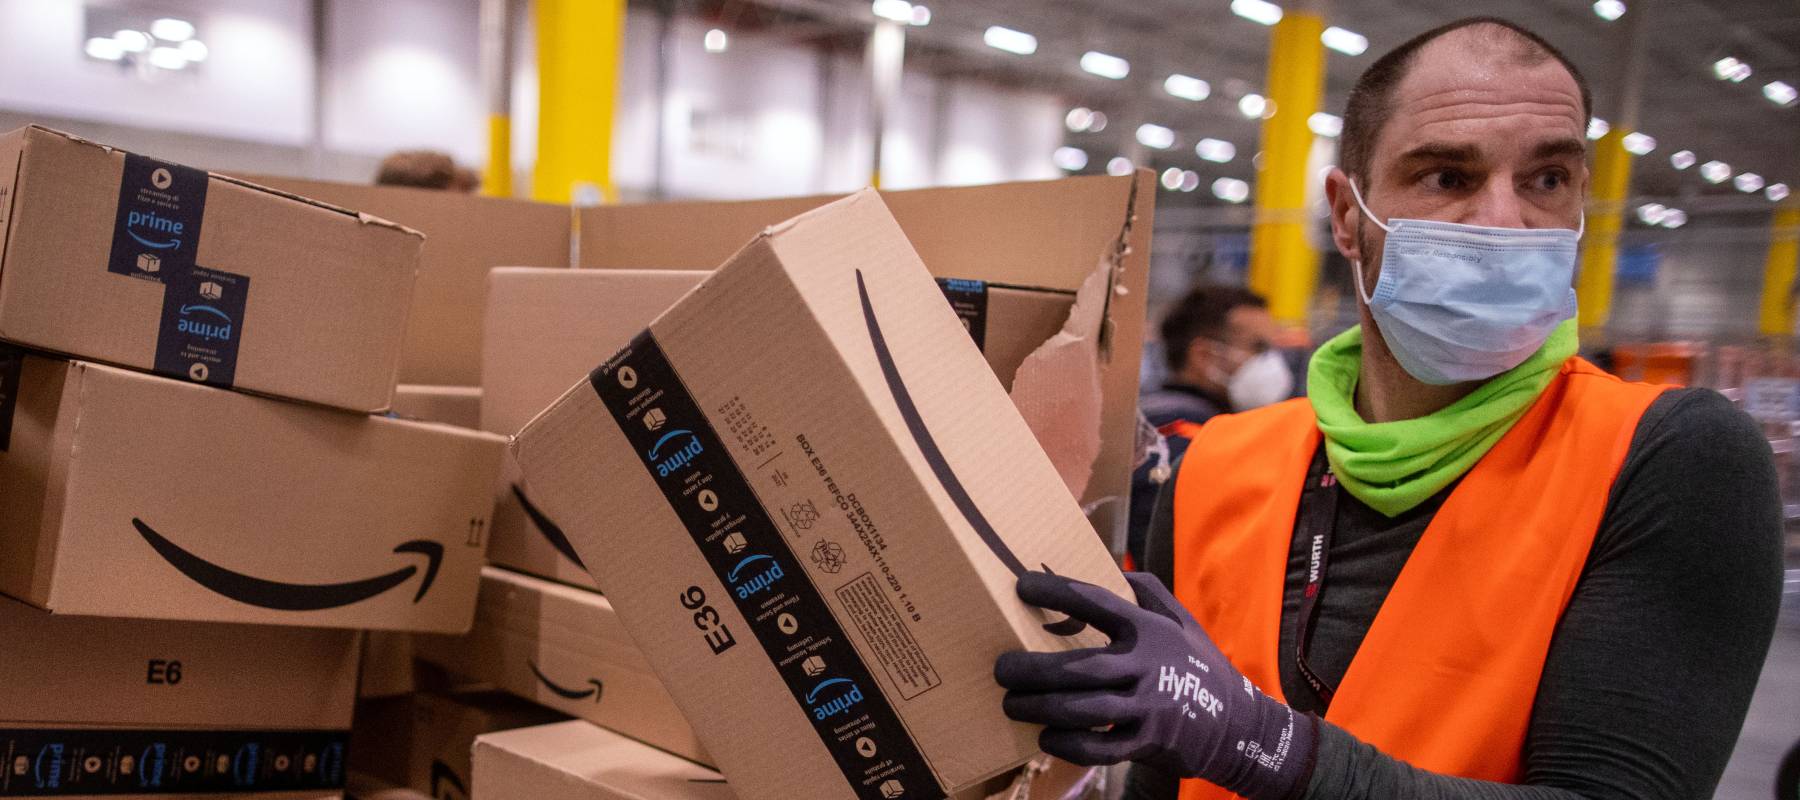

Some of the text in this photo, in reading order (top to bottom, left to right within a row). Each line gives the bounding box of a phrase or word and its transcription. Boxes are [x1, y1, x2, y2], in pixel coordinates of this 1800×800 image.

[127, 211, 183, 234] prime
[177, 318, 231, 340] prime
[653, 436, 703, 476] prime
[796, 433, 814, 457] BOX
[810, 456, 827, 476] E36
[823, 476, 849, 510] FEFCO
[899, 593, 915, 612] 1.10
[911, 613, 921, 621] B
[846, 492, 887, 550] DCBOX1134
[735, 560, 784, 598] prime
[681, 586, 736, 653] E36
[147, 660, 182, 685] E6
[813, 684, 863, 720] prime
[49, 743, 64, 788] prime
